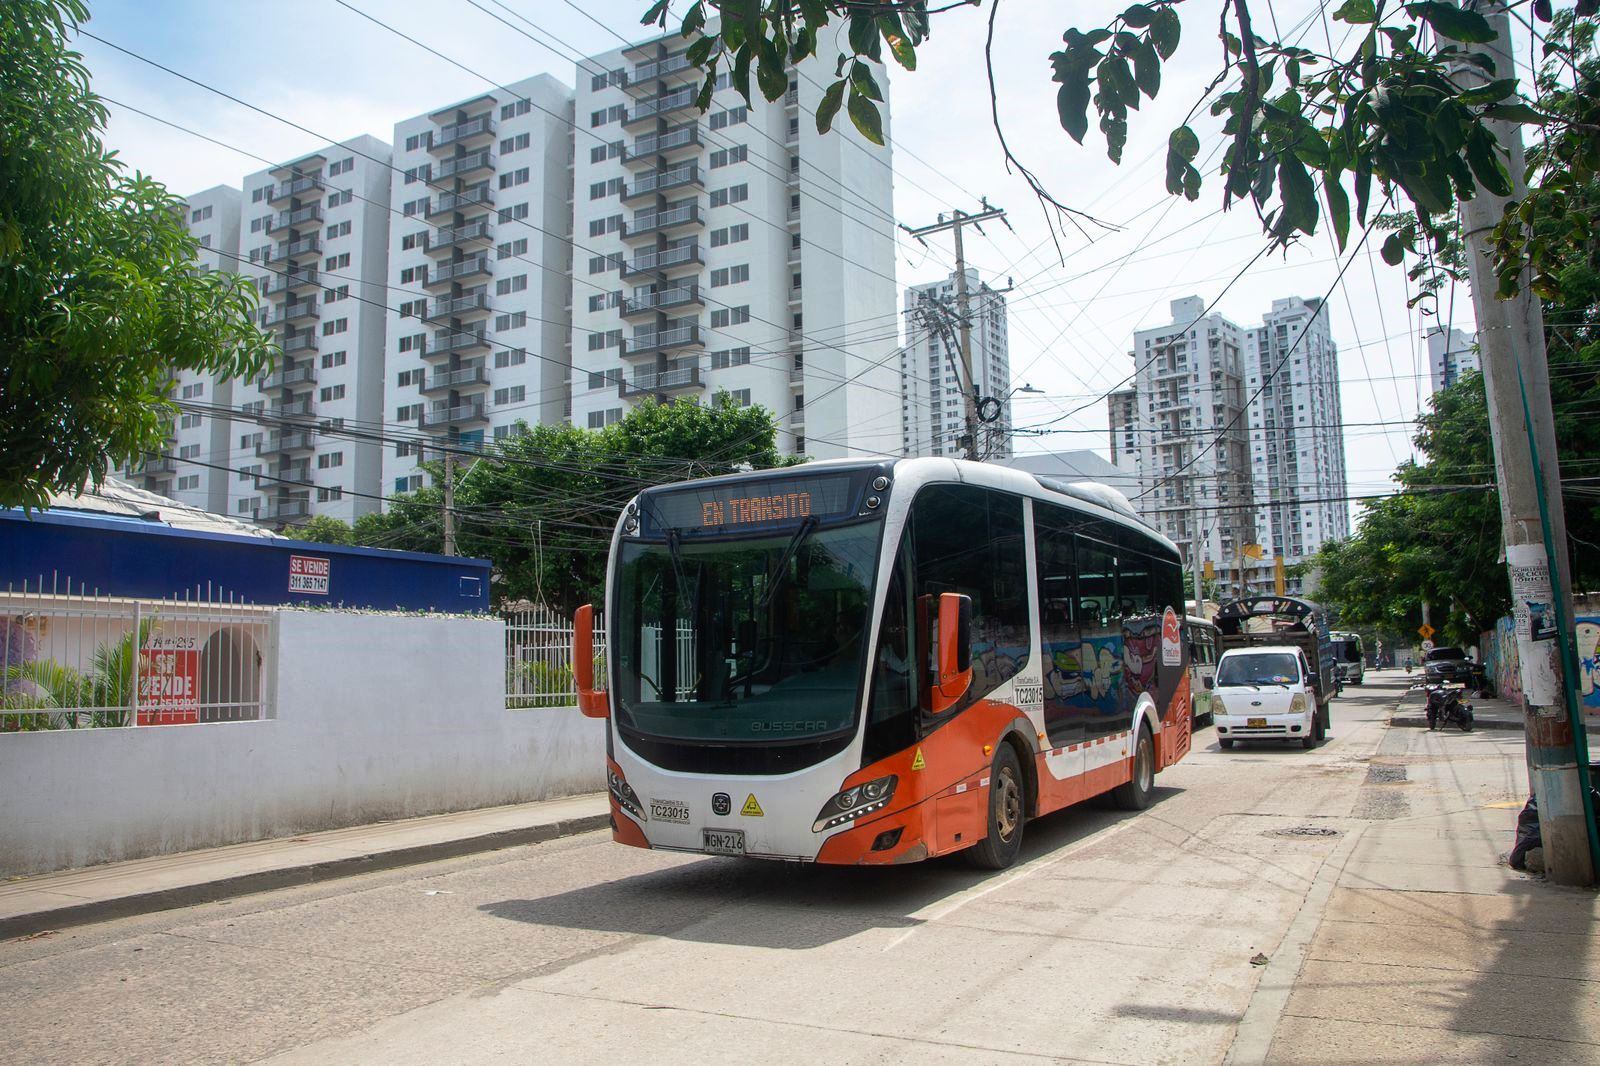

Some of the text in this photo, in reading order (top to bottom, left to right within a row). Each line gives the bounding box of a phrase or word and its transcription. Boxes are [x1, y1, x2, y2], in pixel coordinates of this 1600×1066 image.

[703, 492, 811, 526] EN TRANSITO
[291, 559, 328, 575] SE VENDE
[292, 576, 327, 590] 311 365 7147
[140, 676, 192, 696] VENDE
[1014, 687, 1042, 704] TC23015
[751, 721, 827, 731] BUSSCAR
[650, 804, 689, 819] TC23015
